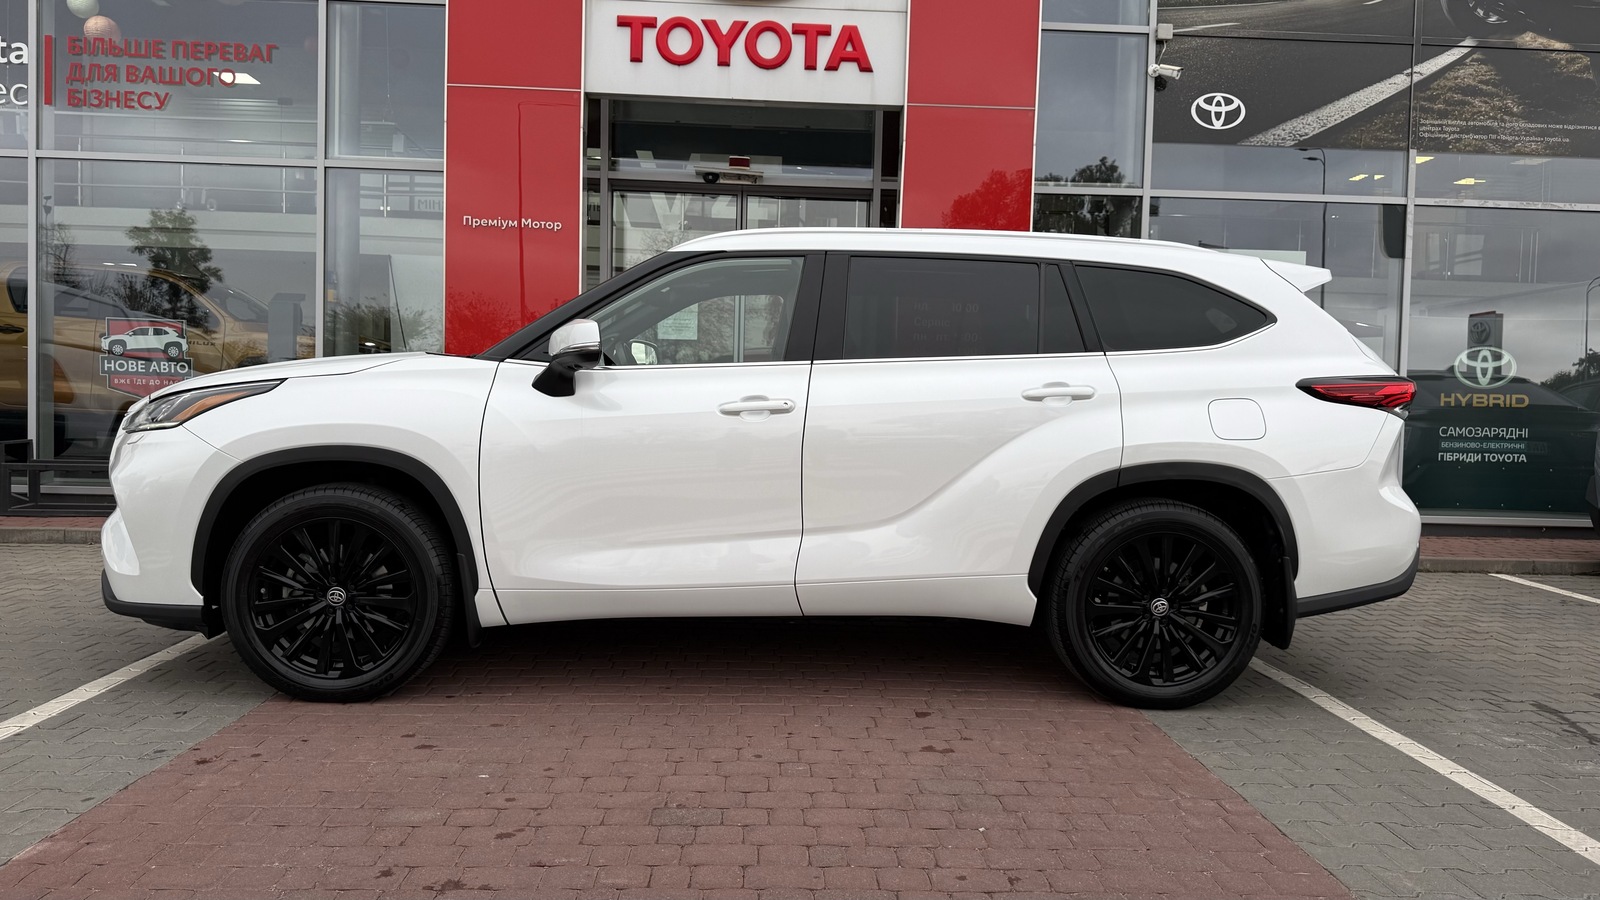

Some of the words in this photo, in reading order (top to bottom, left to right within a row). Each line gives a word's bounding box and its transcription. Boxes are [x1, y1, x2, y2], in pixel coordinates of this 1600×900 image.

[67, 36, 165, 60] БІЛЬШЕ
[172, 40, 279, 62] ПЕРЕВАГ
[616, 15, 873, 72] TOYOTA
[66, 62, 118, 84] ДЛЯ
[125, 65, 237, 87] ВАШОГО
[67, 88, 170, 110] БІЗНЕСУ
[463, 215, 518, 230] Преміум
[521, 218, 562, 231] Мотор
[104, 360, 146, 372] НОВЕ
[149, 361, 189, 374] АВТО
[1439, 393, 1530, 408] HYBRID
[1439, 426, 1529, 440] САМОЗАРЯДНІ
[1440, 441, 1525, 449] БЕНЗИНОВО-ЕЛЕКТРИЧНІ
[1438, 452, 1482, 463] ГІБРИДИ
[1484, 453, 1527, 463] TOYOTA
